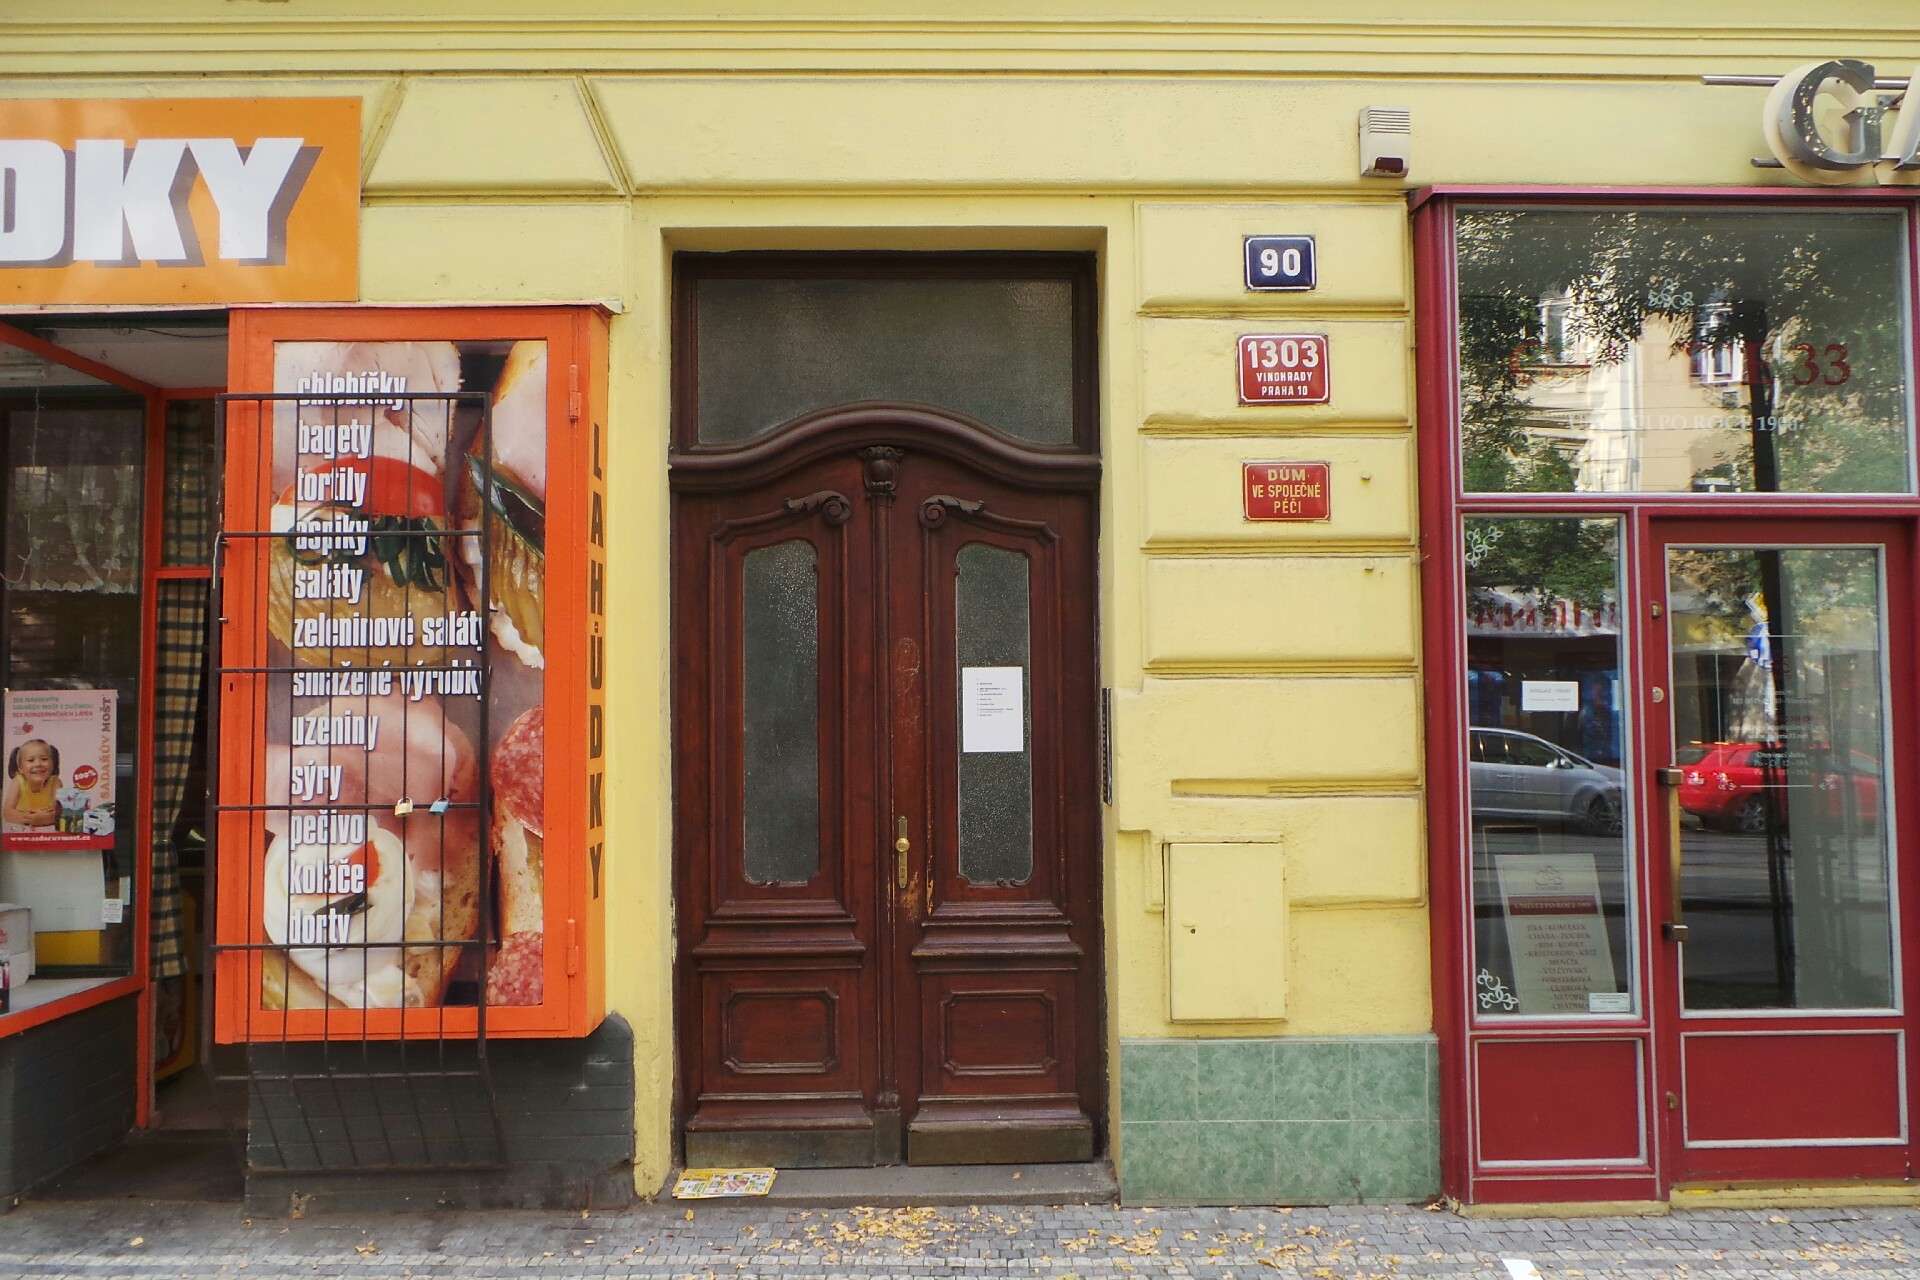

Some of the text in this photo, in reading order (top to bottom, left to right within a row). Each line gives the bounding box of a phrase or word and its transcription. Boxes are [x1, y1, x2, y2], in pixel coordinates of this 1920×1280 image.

[1260, 248, 1301, 277] 90
[1247, 340, 1319, 369] 1303
[1256, 371, 1313, 383] VINOHRADY
[1261, 385, 1308, 397] PRAHA 10
[298, 419, 373, 459] bagety
[297, 467, 367, 507] tortily
[1252, 482, 1321, 498] VE SPOLEČNÉ
[1273, 498, 1302, 514] PÉČI
[296, 515, 369, 556] aspiky
[294, 563, 363, 604] saláty
[294, 610, 483, 652] zeleninové salát
[400, 659, 484, 701] výrobk
[292, 710, 379, 751] uzeniny
[291, 760, 343, 801] sýry
[290, 808, 365, 851] pečivo
[290, 857, 365, 894] koláče
[289, 907, 350, 952] dorty
